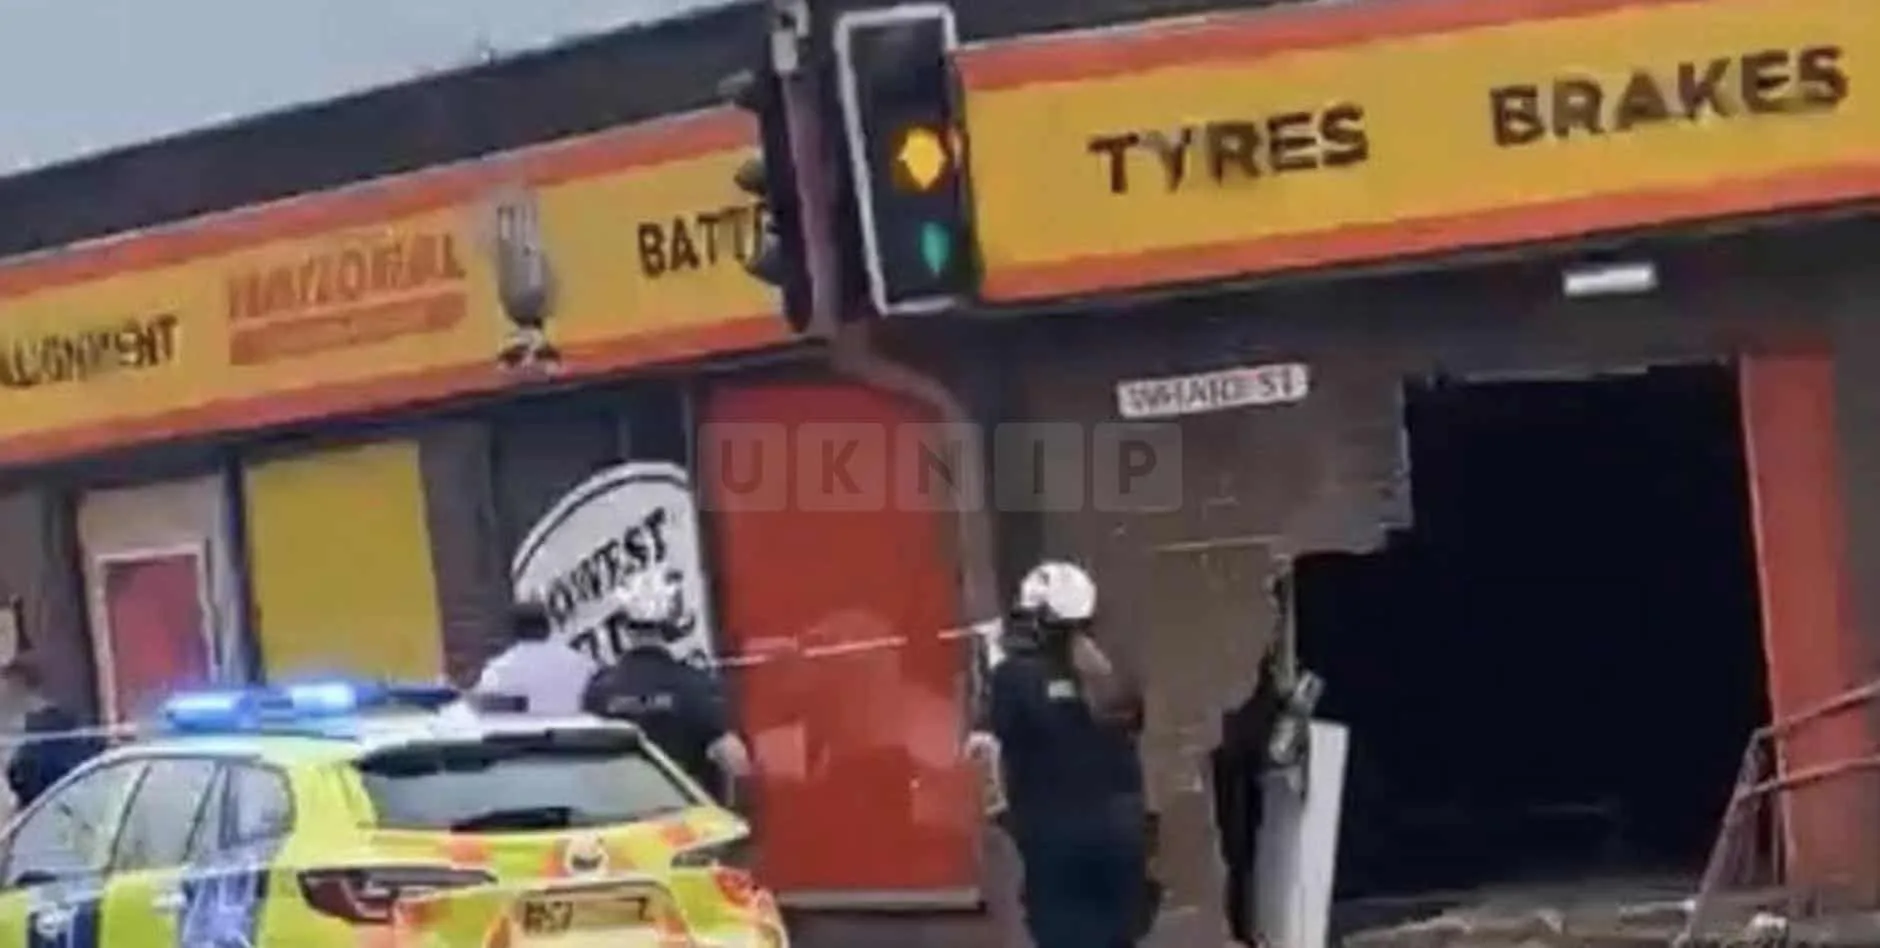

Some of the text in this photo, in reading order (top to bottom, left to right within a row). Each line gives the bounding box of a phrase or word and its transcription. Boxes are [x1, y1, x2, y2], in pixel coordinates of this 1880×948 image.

[1088, 46, 1849, 194] TYRES BRAKES
[547, 506, 666, 630] OWEST
